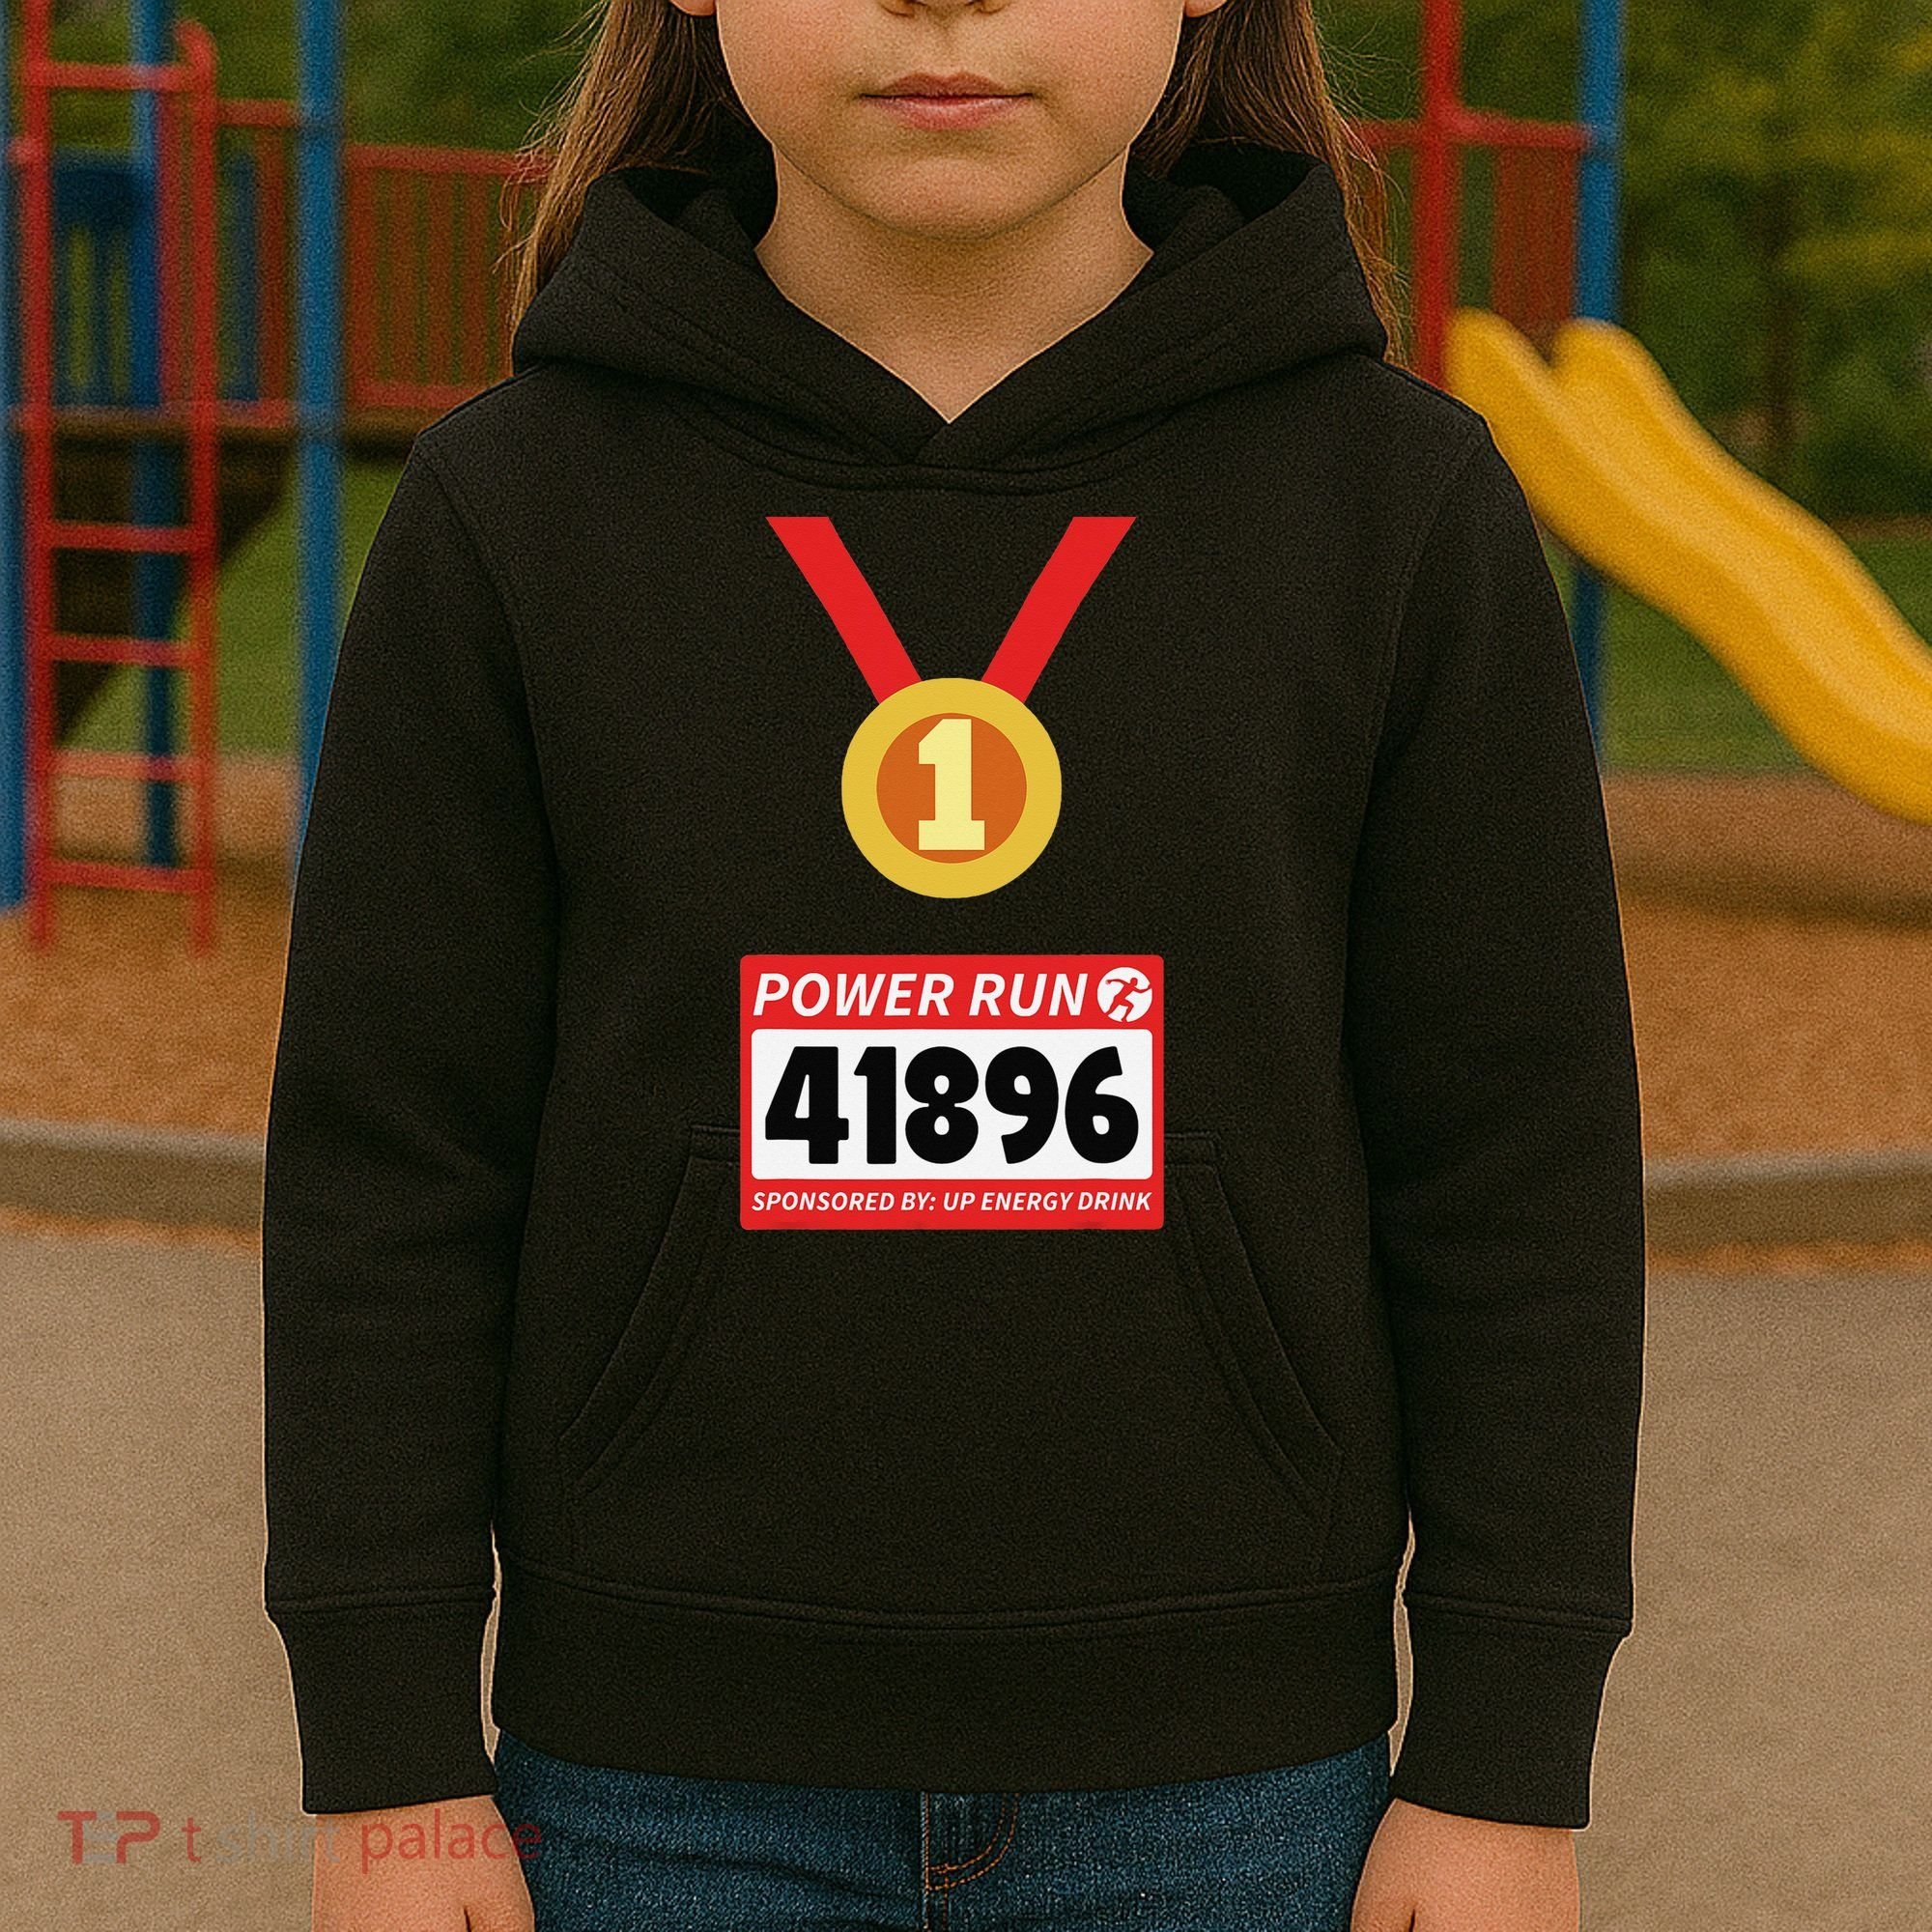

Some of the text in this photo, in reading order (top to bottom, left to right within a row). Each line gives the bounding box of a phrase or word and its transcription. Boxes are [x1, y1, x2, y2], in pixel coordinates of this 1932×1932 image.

[919, 719, 985, 850] 1
[753, 972, 1089, 1017] POWER RUN
[765, 1046, 1139, 1165] 41896
[752, 1191, 1151, 1211] SPONSORED BY: UP ENERGY DRINK
